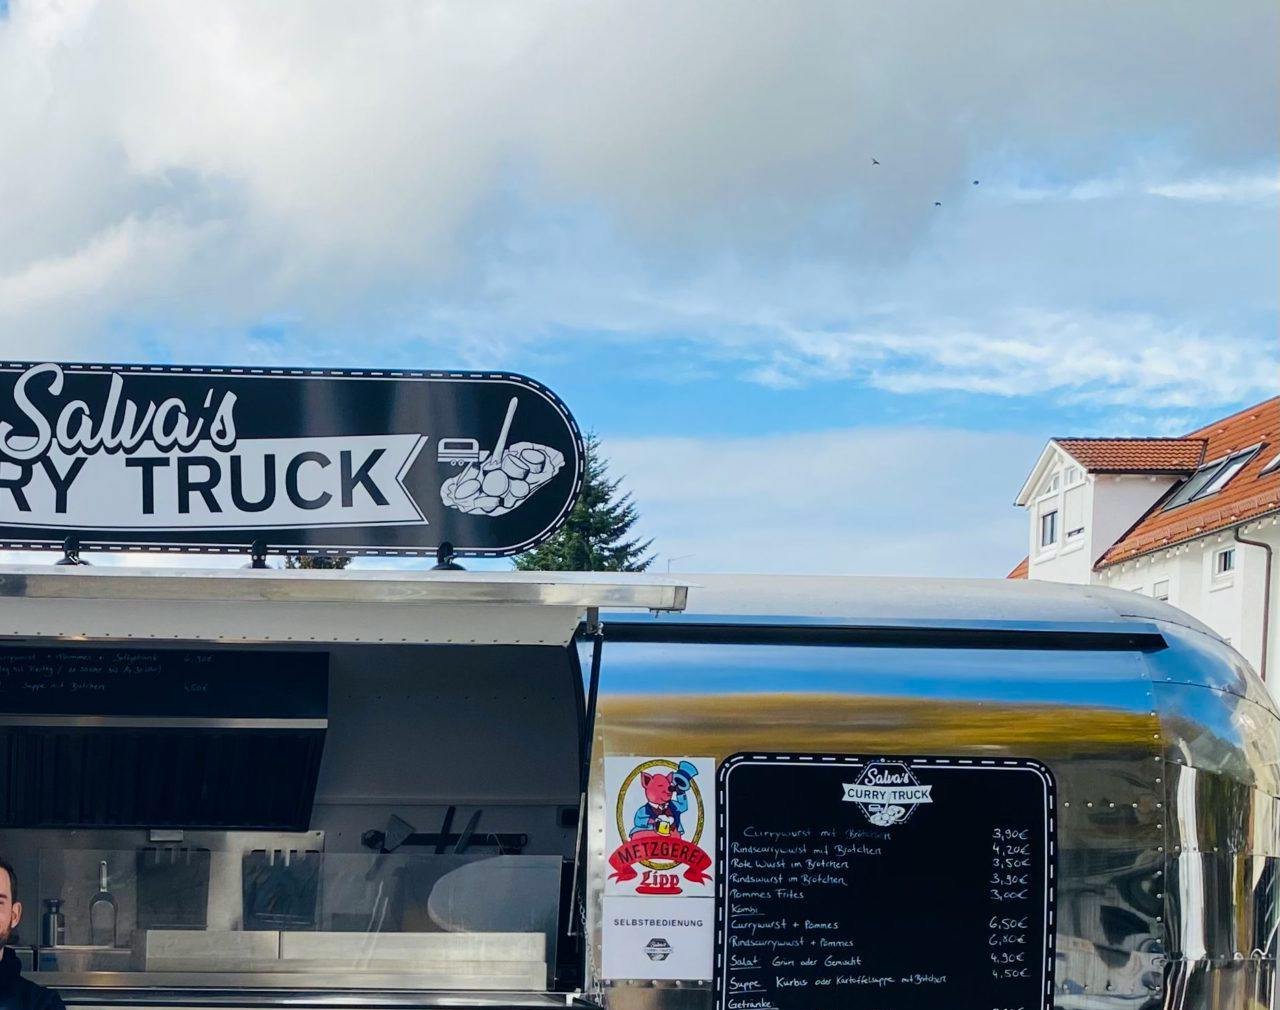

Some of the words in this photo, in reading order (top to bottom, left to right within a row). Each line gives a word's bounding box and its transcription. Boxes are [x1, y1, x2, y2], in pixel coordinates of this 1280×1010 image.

[124, 448, 389, 516] TRUCK
[864, 768, 909, 786] Salva's
[847, 789, 886, 800] CURRY
[891, 790, 929, 800] TRUCK
[617, 841, 704, 867] METZGEREI
[613, 918, 703, 928] SELBSTBEDIENUNG
